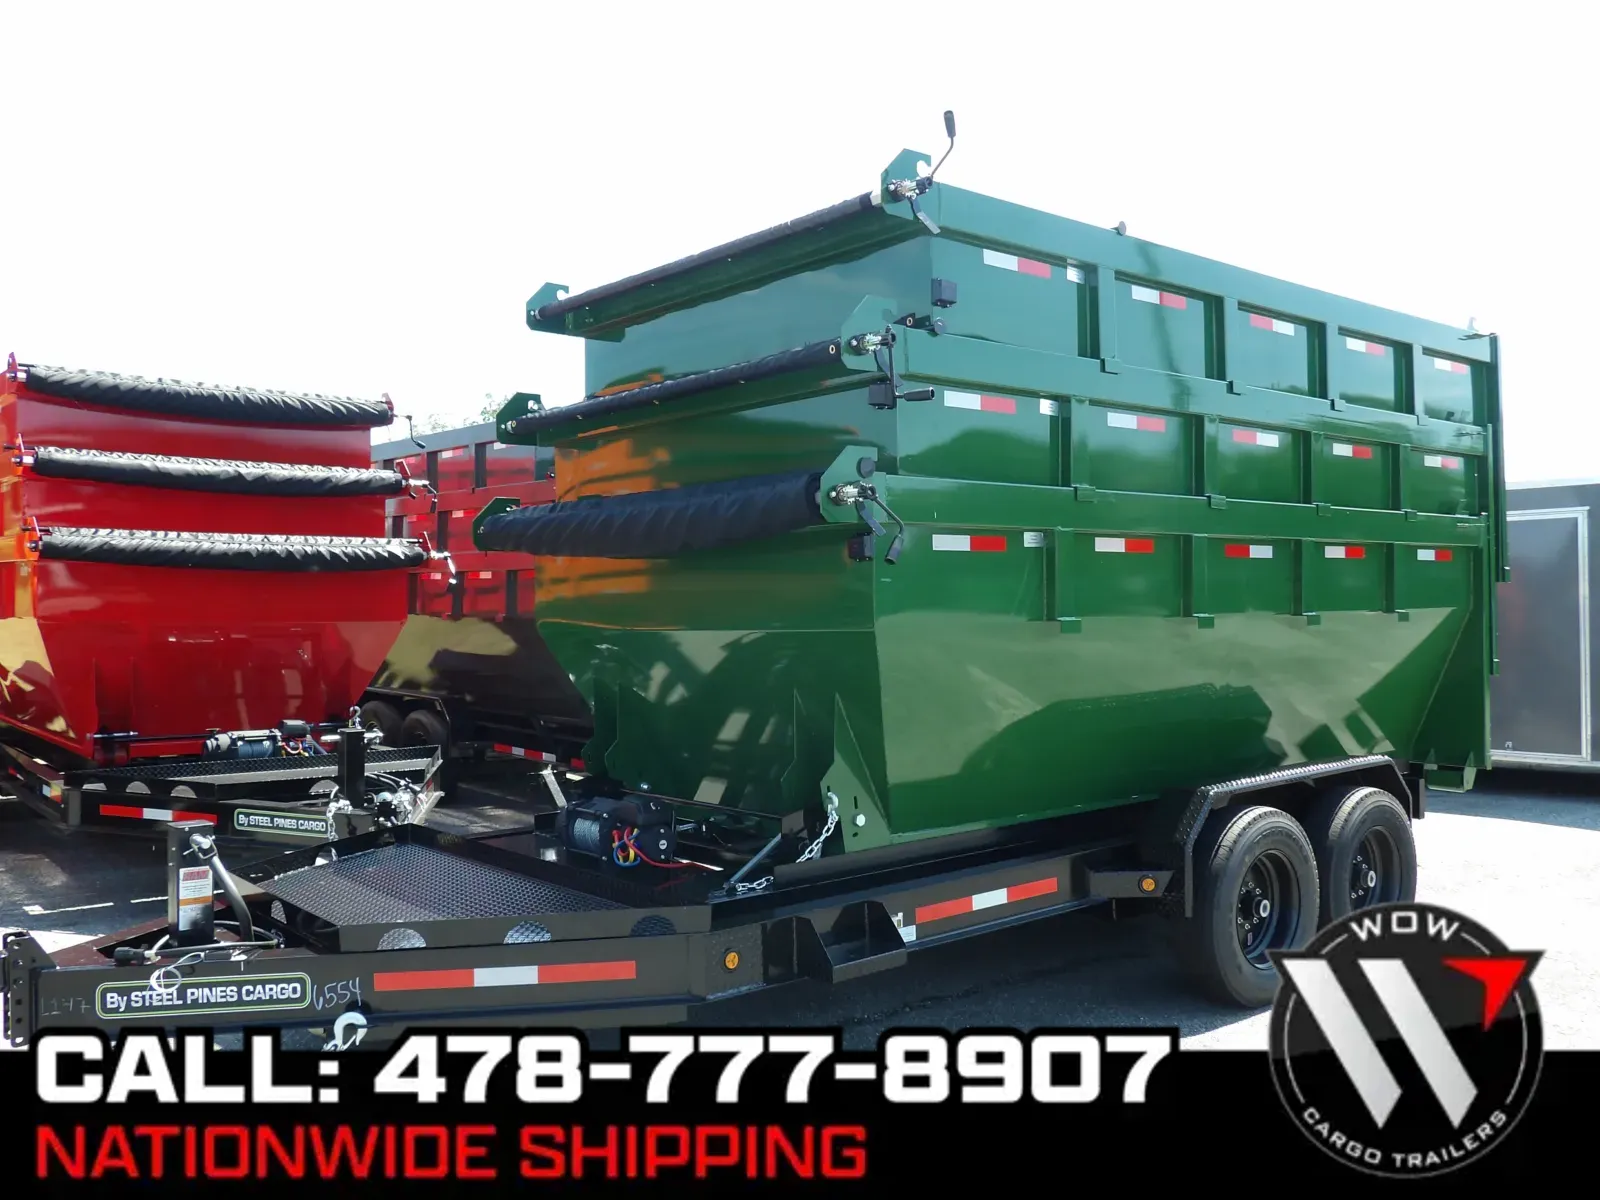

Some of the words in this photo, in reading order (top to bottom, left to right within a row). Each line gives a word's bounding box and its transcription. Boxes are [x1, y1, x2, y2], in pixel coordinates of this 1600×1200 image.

[238, 815, 249, 826] By
[250, 816, 273, 827] STEEL
[273, 818, 297, 829] PINES
[298, 820, 326, 832] CARGO
[106, 992, 128, 1012] By
[130, 989, 183, 1008] STEEL
[186, 986, 238, 1004] PINES
[241, 983, 301, 1001] CARGO
[312, 977, 362, 1011] 6554
